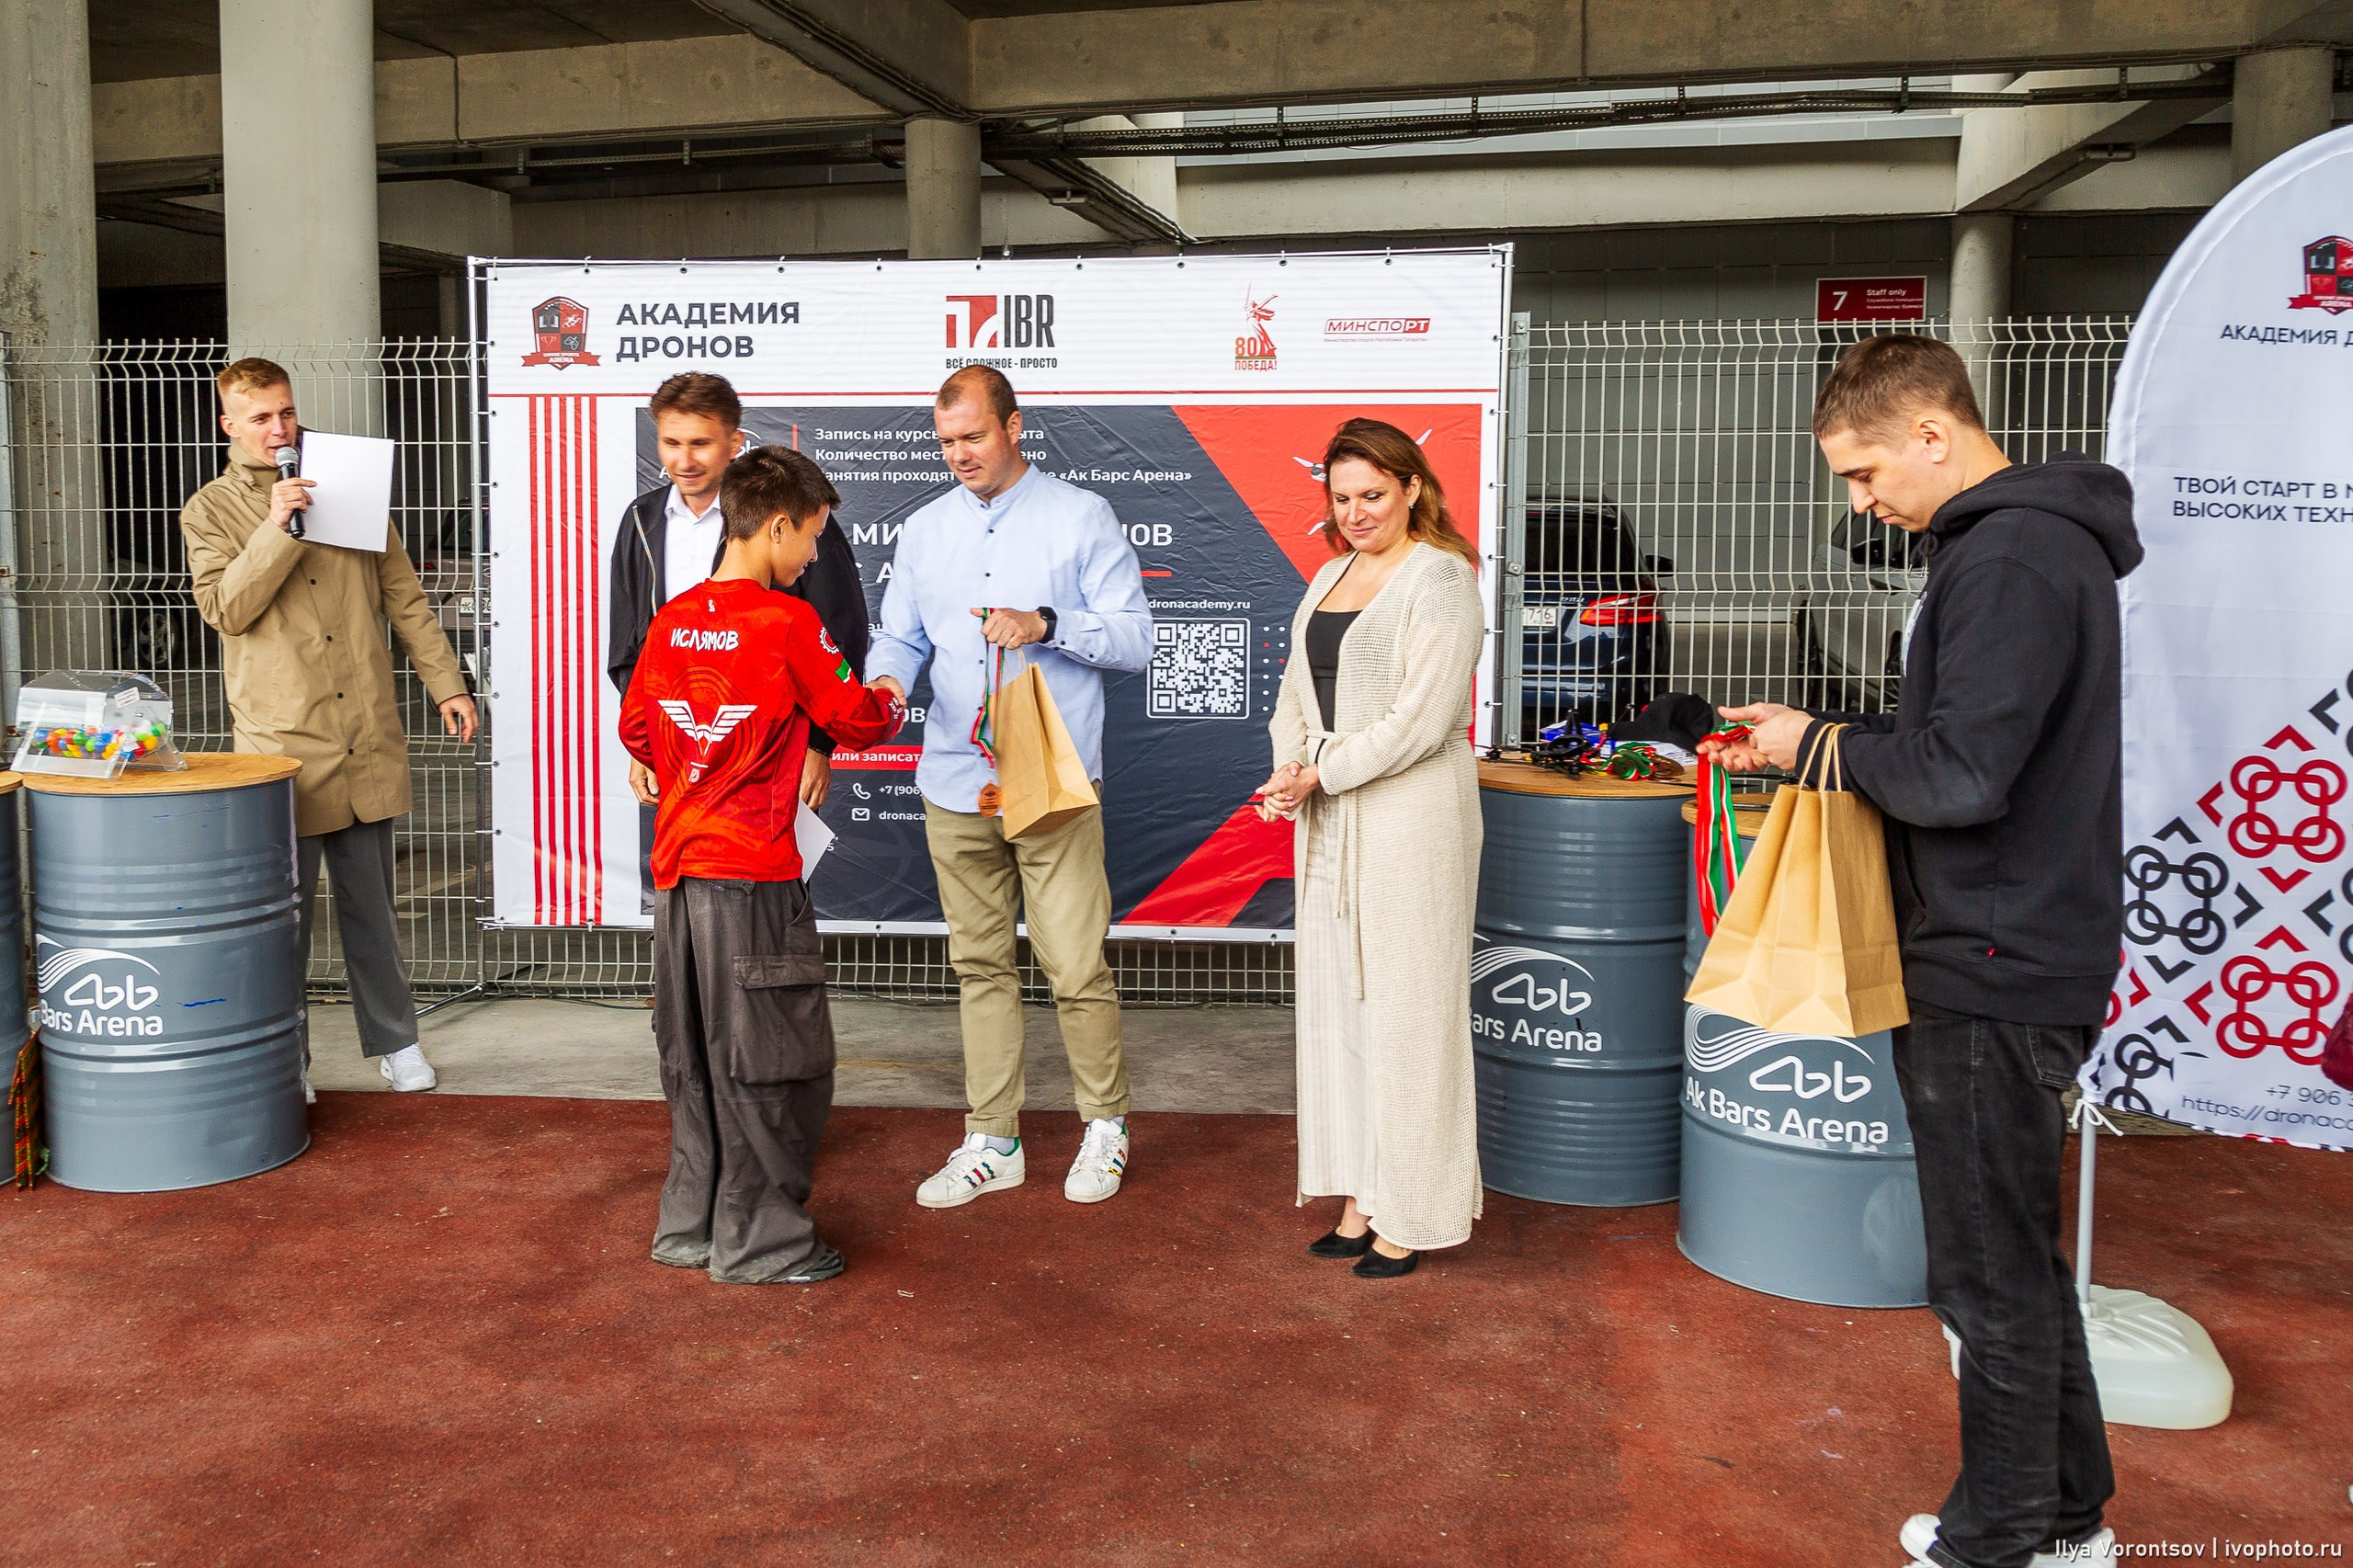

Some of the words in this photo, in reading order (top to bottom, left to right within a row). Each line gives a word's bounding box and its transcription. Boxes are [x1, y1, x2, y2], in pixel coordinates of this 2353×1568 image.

[1833, 290, 1848, 311] 7
[616, 301, 800, 328] АКАДЕМИЯ
[1003, 294, 1055, 347] IBR
[1328, 321, 1429, 332] МИНСПОРТ
[2220, 324, 2337, 345] АКАДЕМИЯ
[616, 335, 754, 362] ДРОНОВ
[1235, 336, 1256, 357] 80
[946, 356, 963, 369] ВСЁ
[1020, 358, 1058, 369] ПРОСТО
[1234, 359, 1278, 371] ПОБЕДА!
[814, 427, 871, 440] Запись
[873, 430, 892, 440] на
[815, 449, 908, 460] Количество
[824, 469, 880, 482] анятия
[882, 472, 955, 483] проходят
[1059, 469, 1089, 482] «Ак
[1091, 469, 1131, 483] Барс
[1132, 469, 1193, 483] Арена»
[2173, 475, 2236, 494] ТВОЙ
[2244, 480, 2316, 499] СТАРТ
[2323, 483, 2338, 499] В
[2173, 500, 2288, 522] ВЫСОКИХ
[1147, 599, 1251, 611] dronacademy.ru
[670, 627, 739, 652] ИСЛЯМОВ
[832, 753, 859, 762] или
[879, 785, 892, 795] +7
[76, 1009, 164, 1036] Arena
[1470, 1007, 1506, 1040] ars
[1510, 1018, 1603, 1052] Arena
[2265, 1084, 2292, 1100] +7
[2297, 1087, 2342, 1106] 906
[1686, 1076, 1706, 1112] Ak
[1710, 1088, 1772, 1131] Bars
[1779, 1108, 1889, 1144] Arena
